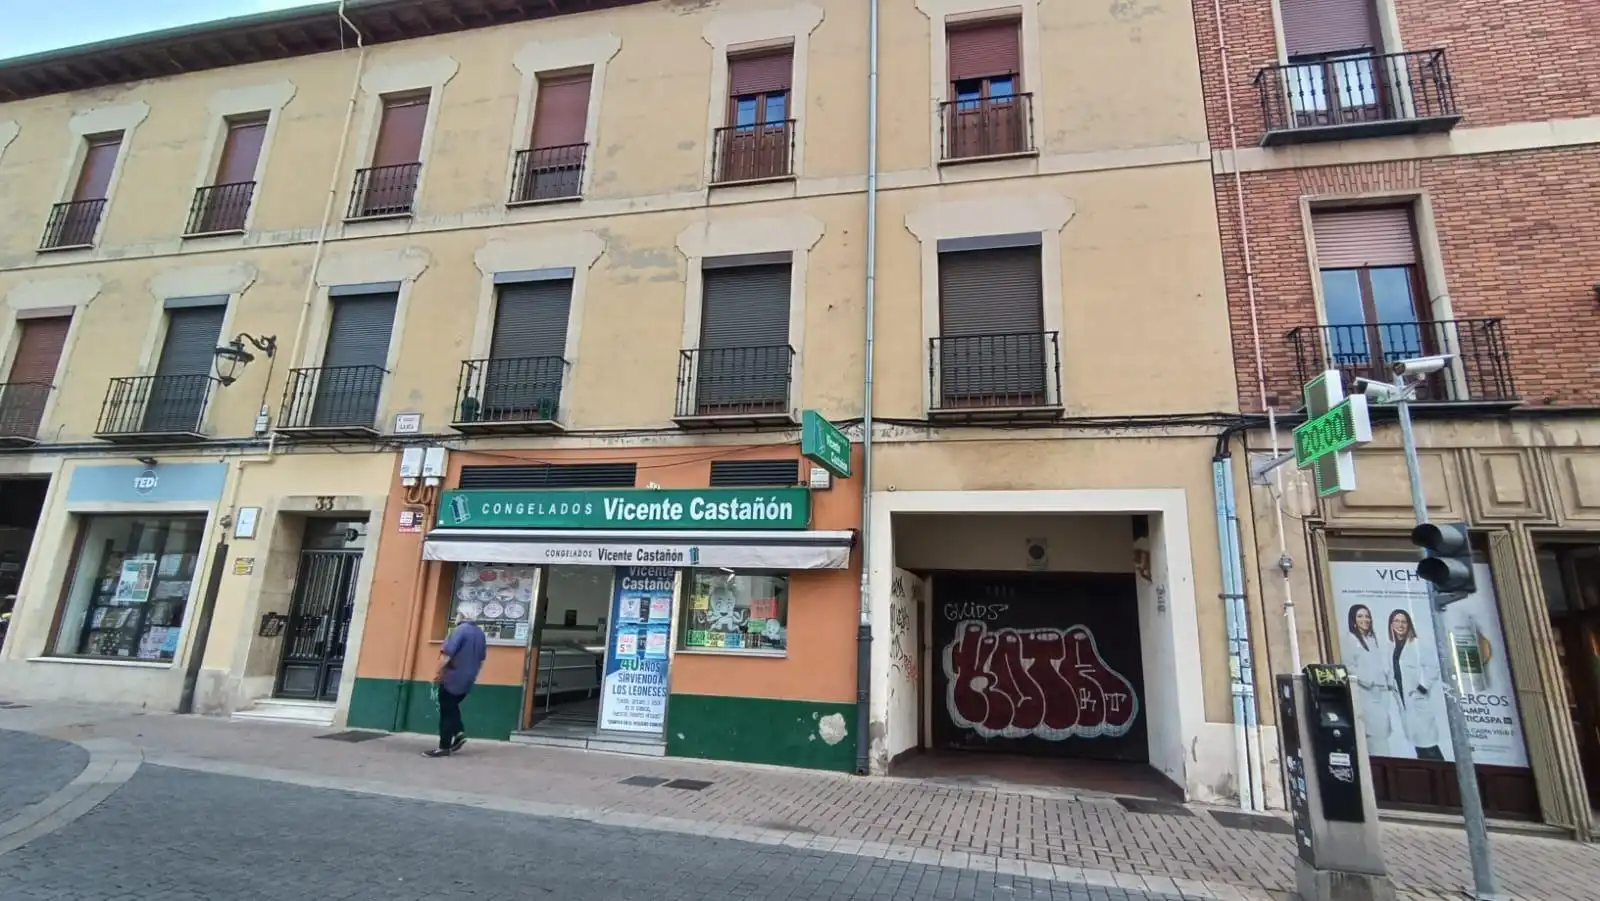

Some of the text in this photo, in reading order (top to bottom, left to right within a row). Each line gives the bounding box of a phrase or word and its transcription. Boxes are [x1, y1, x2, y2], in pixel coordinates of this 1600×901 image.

[315, 495, 335, 512] 33
[481, 496, 793, 520] CONGELADOS Vicente Castañón
[545, 547, 684, 562] CONGELADOS Vicente Castañón
[1376, 569, 1420, 581] VICH
[617, 672, 657, 685] SIRVIENDO
[612, 684, 668, 697] LOS LEONESES
